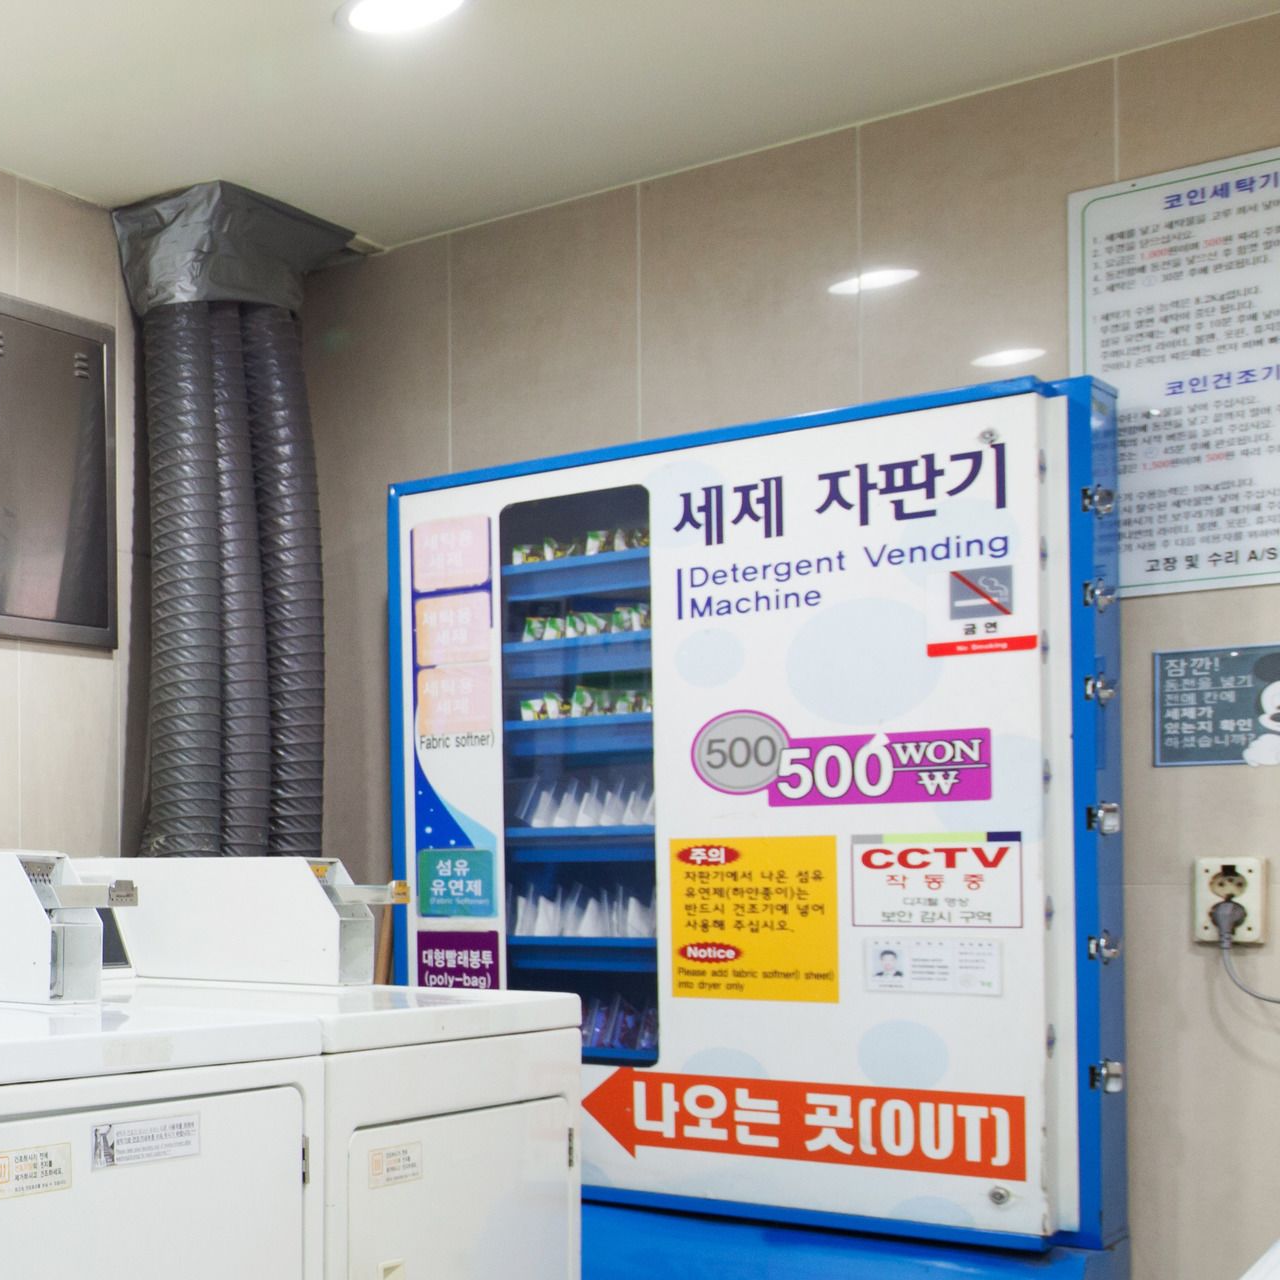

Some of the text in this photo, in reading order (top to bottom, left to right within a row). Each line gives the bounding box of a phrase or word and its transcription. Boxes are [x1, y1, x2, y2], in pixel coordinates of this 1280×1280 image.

[1162, 170, 1280, 211] 코인세탁기
[1164, 360, 1280, 397] 코인건조기
[673, 442, 1007, 547] 세제 자판기
[689, 533, 1010, 589] Detergent Vending
[1145, 546, 1279, 573] 고장 및 수리 A/S
[689, 588, 822, 620] Machine
[1165, 656, 1220, 678] 잠깐!
[1164, 705, 1215, 721] 세제가
[1164, 717, 1254, 735] 있는지 확인
[420, 729, 496, 751] Fabric softner)
[705, 735, 778, 769] 500
[776, 737, 984, 800] 500 WON
[688, 847, 726, 865] 주의
[860, 845, 1011, 870] CCTV
[436, 858, 471, 877] 섬유
[684, 869, 753, 885] 자판기에서
[795, 869, 825, 884] 섬유
[430, 878, 482, 897] 유연제
[684, 902, 826, 918] 반드시 건조기에 넣어
[944, 896, 970, 907] 영상
[684, 918, 795, 934] 사용해 주십시오.
[881, 910, 993, 924] 보안 감시 구역
[422, 948, 494, 969] 대형빨래봉투
[686, 945, 737, 960] Notice
[424, 970, 492, 989] (poly-bag)
[677, 966, 758, 979] Please add fabric
[677, 980, 745, 992] into dryer only
[632, 1079, 1011, 1168] 나오는 곳(OUT)
